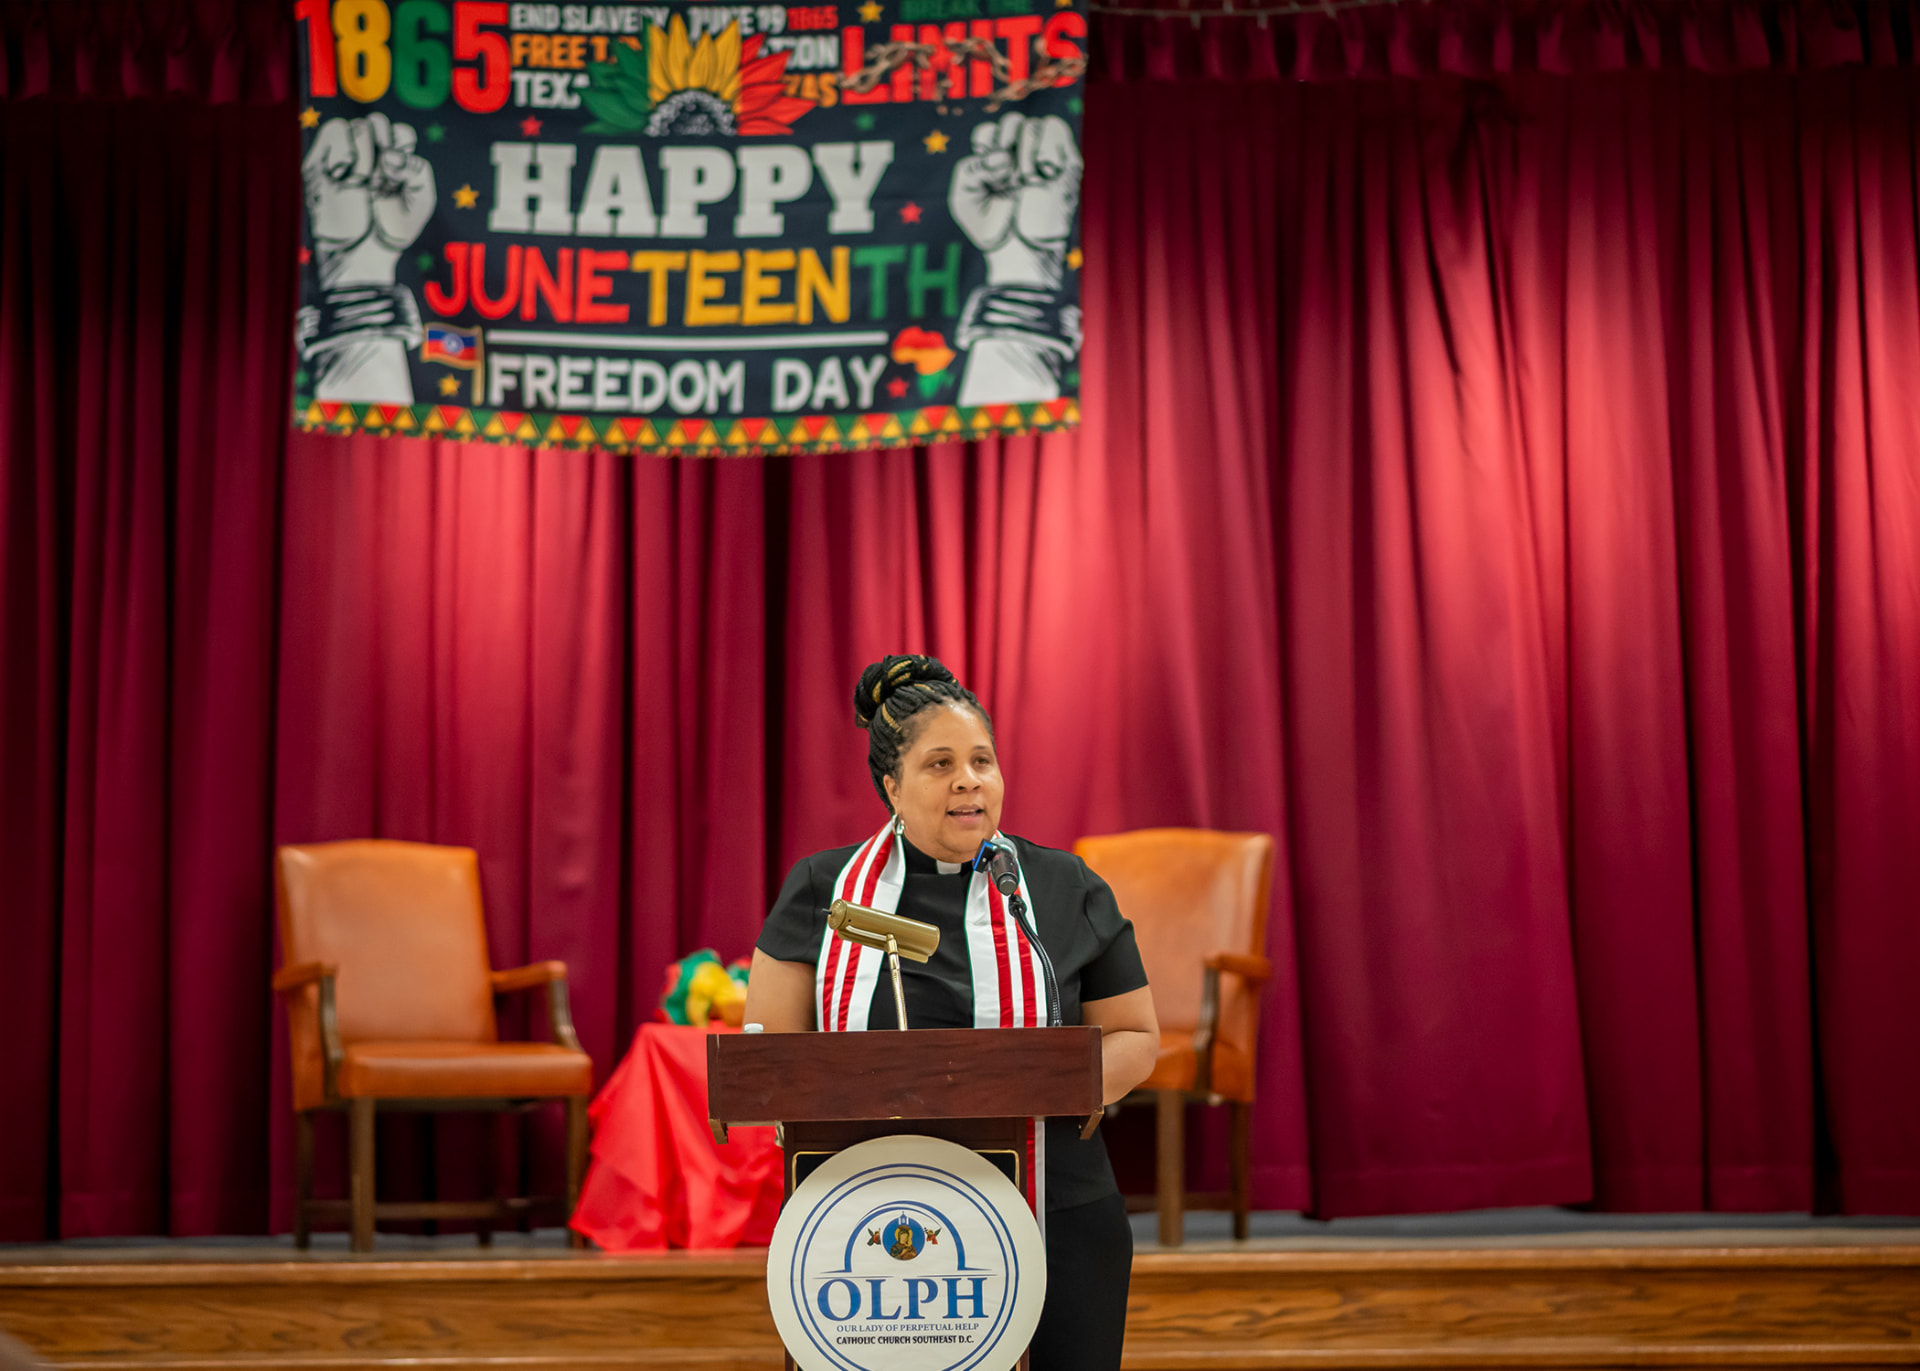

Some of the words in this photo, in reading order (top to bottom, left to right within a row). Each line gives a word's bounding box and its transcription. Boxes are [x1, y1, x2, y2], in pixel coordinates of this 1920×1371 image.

[510, 3, 561, 31] END
[756, 5, 787, 34] 19
[295, 0, 511, 114] 1865
[510, 34, 588, 69] FREE
[842, 11, 1088, 105] LIMITS
[488, 141, 895, 238] HAPPY
[424, 241, 961, 327] JUNETEENTH
[488, 353, 745, 414] FREEDOM
[772, 355, 888, 412] DAY
[817, 1277, 989, 1321] OLPH
[836, 1324, 858, 1333] OUR
[859, 1324, 884, 1332] LADY
[885, 1323, 899, 1332] OF
[900, 1323, 954, 1332] PERPETUAL
[955, 1322, 980, 1331] HELP
[836, 1336, 876, 1345] CATHOLIC
[878, 1335, 911, 1344] CHURCH
[912, 1335, 957, 1344] SOUTHEAST
[958, 1334, 975, 1343] D.C.
